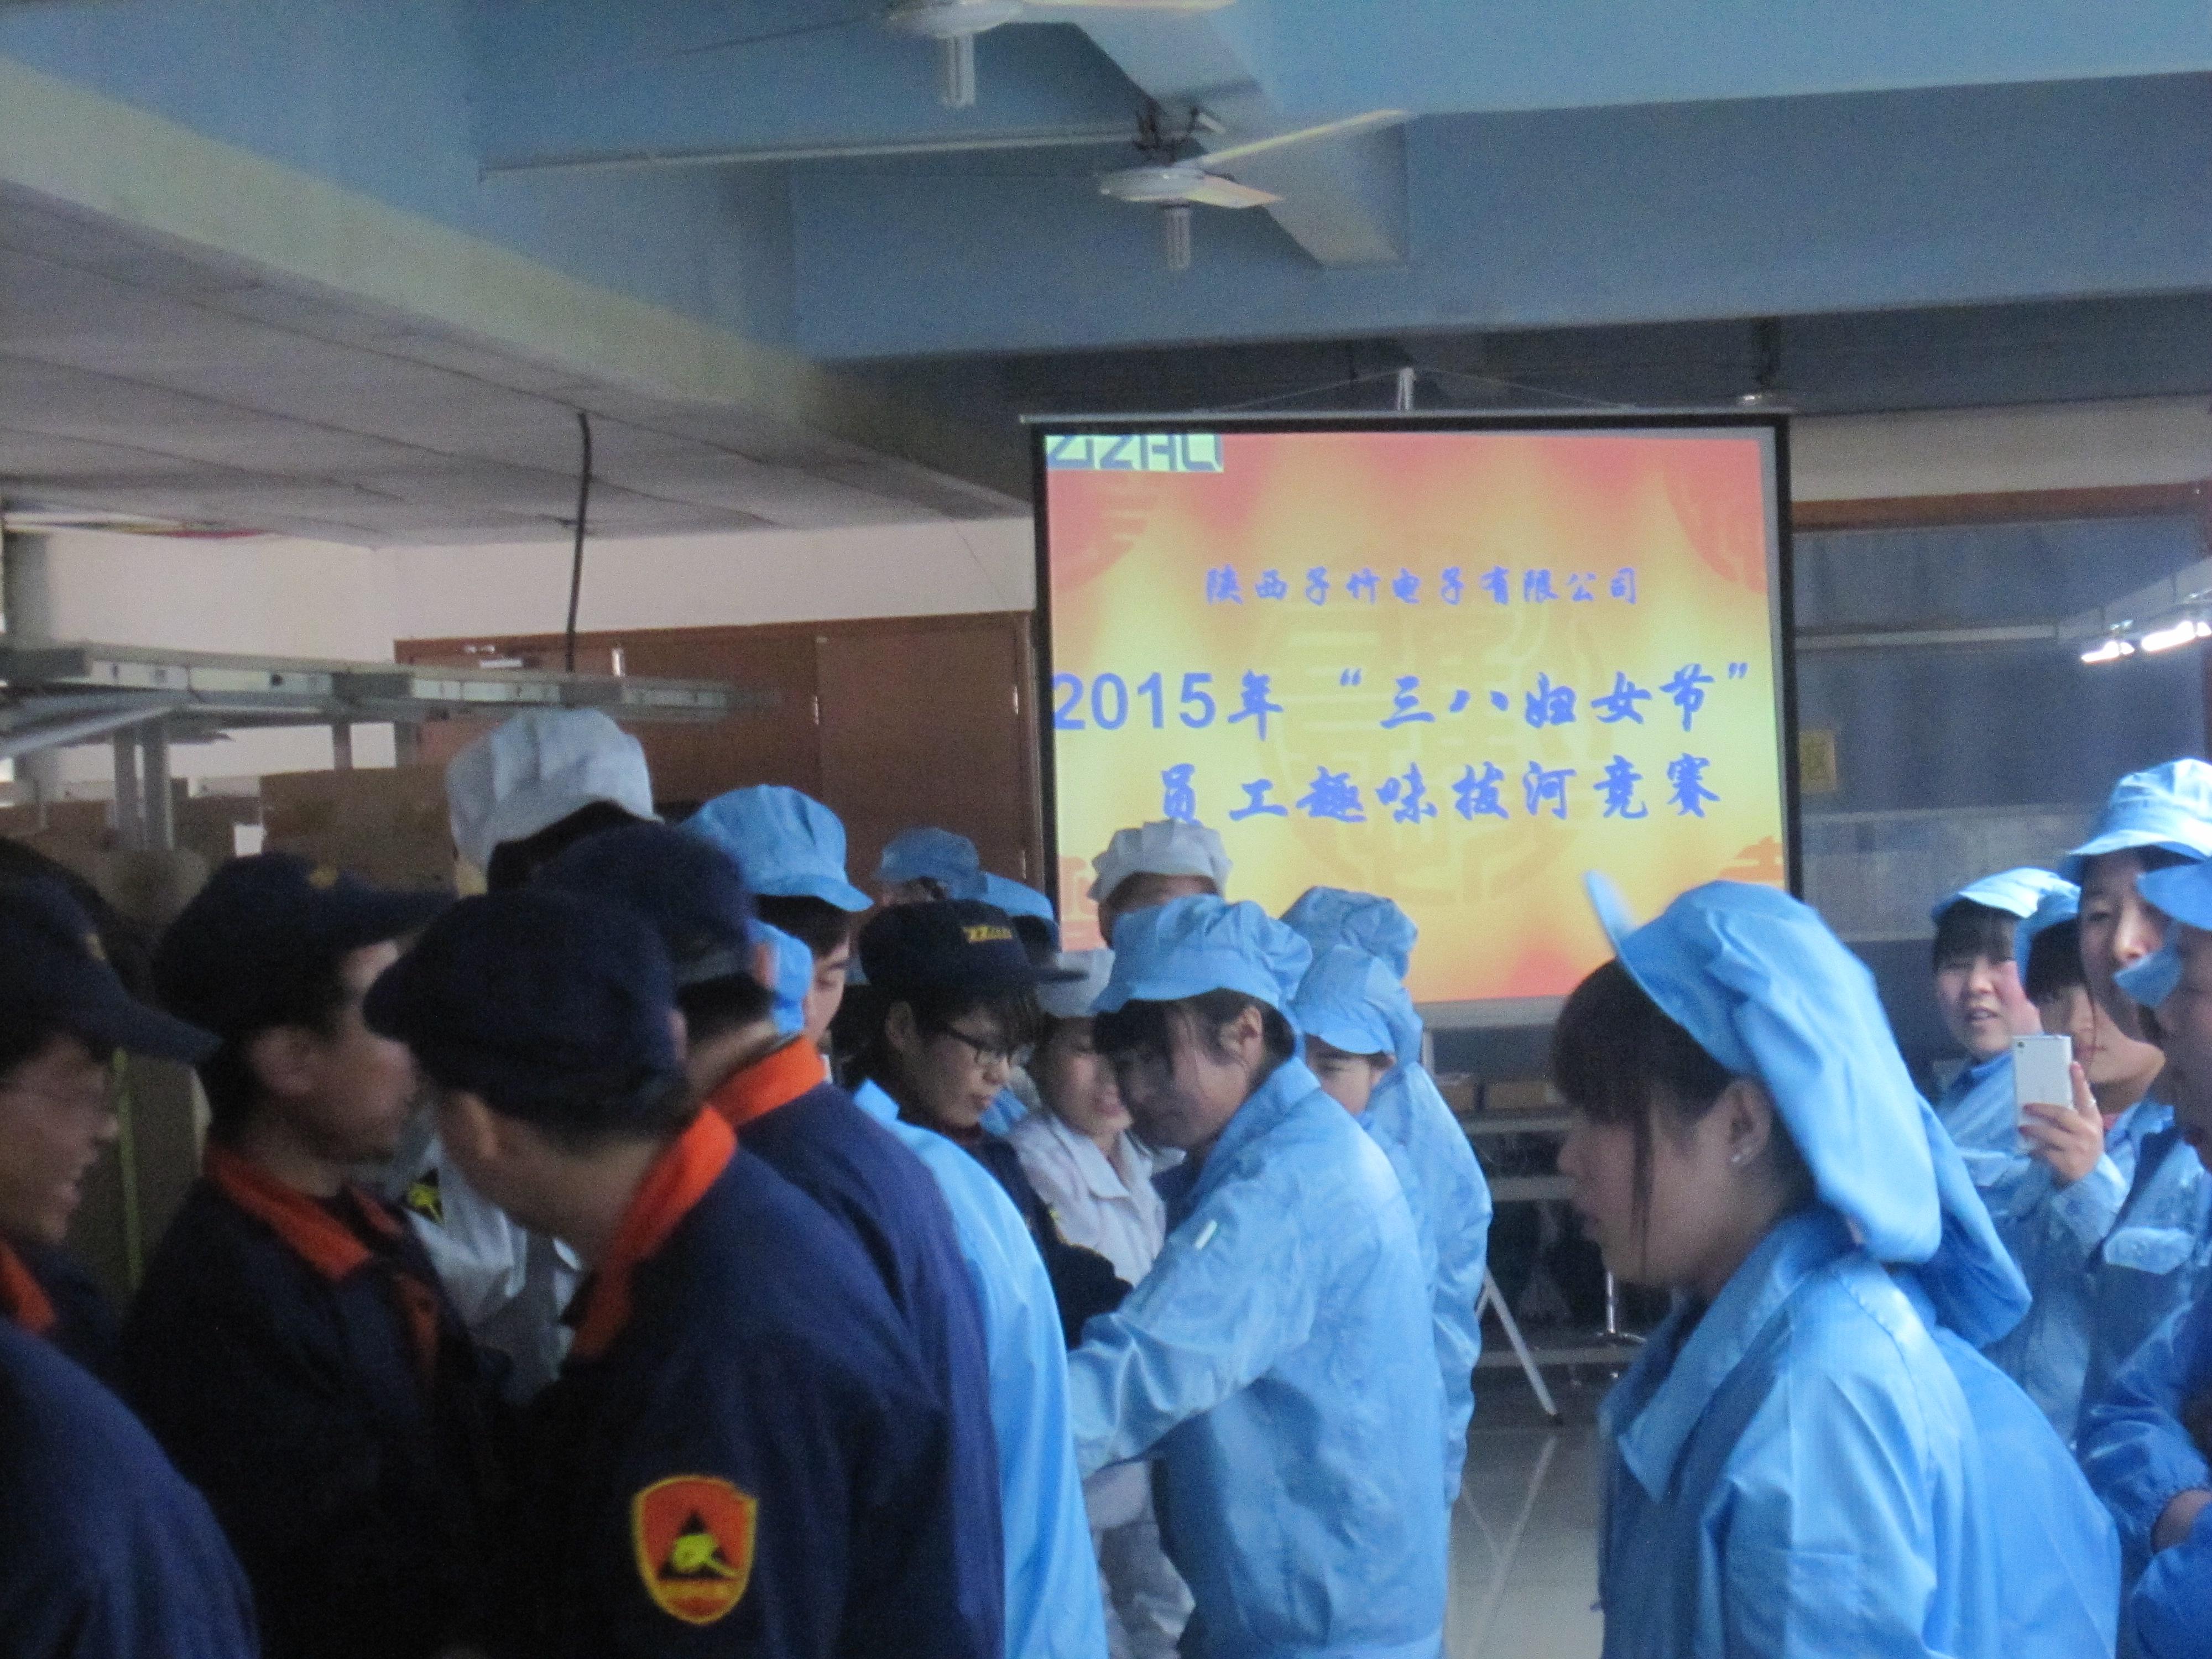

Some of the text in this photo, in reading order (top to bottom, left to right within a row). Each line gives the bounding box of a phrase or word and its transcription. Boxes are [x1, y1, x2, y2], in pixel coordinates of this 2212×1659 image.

[1205, 565, 1637, 606] 陕西子竹电子有限公司
[1160, 752, 1722, 826] 员工趣味拔河竞赛
